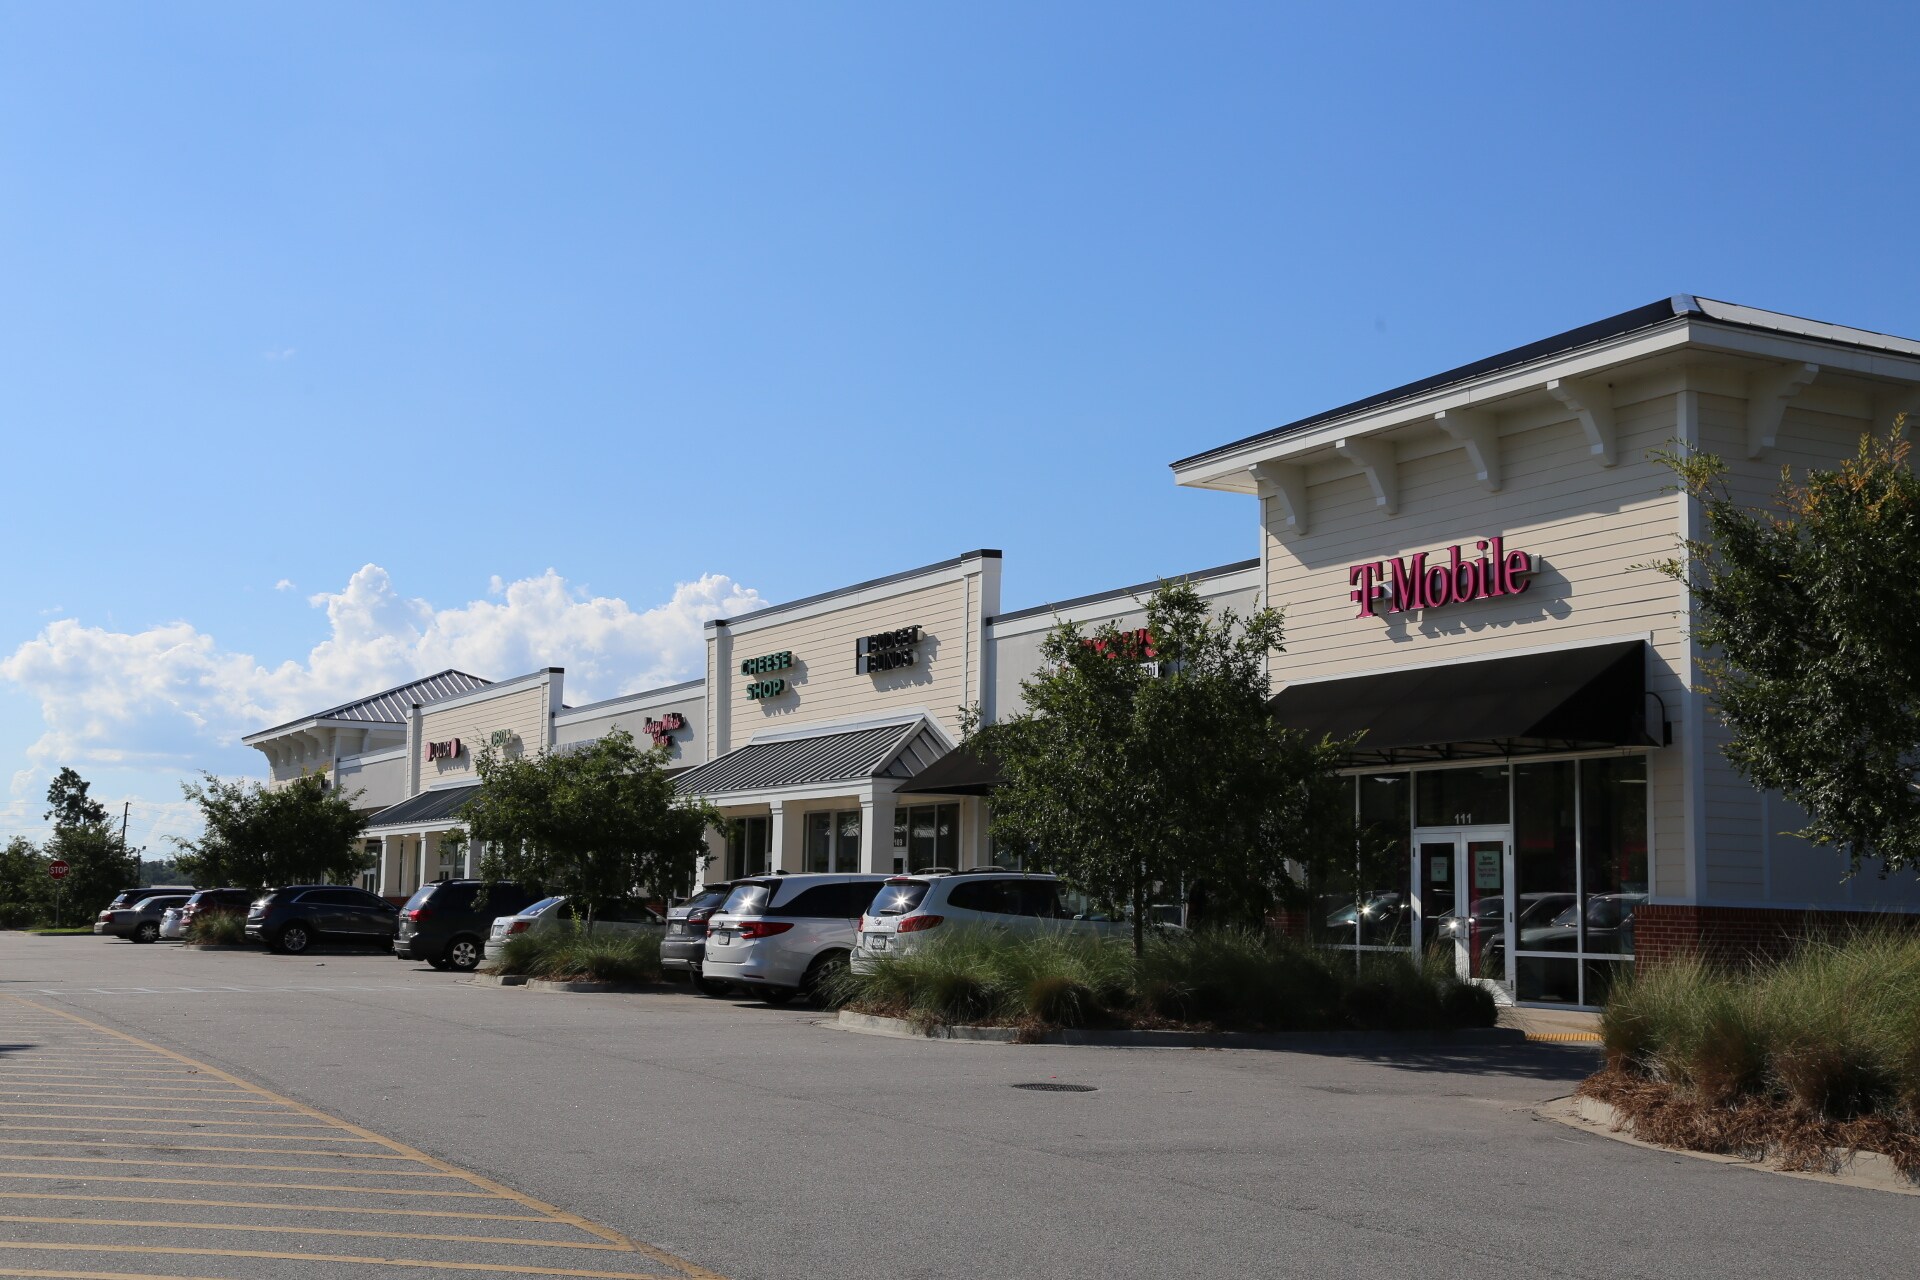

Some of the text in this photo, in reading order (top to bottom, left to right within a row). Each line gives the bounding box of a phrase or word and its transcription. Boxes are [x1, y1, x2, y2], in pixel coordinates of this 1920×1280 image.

[870, 624, 921, 652] BUDGET
[741, 651, 792, 676] CHEESE
[870, 648, 913, 672] BLINDS
[747, 679, 785, 700] SHOP
[1454, 813, 1471, 824] 111
[51, 866, 68, 875] STOP
